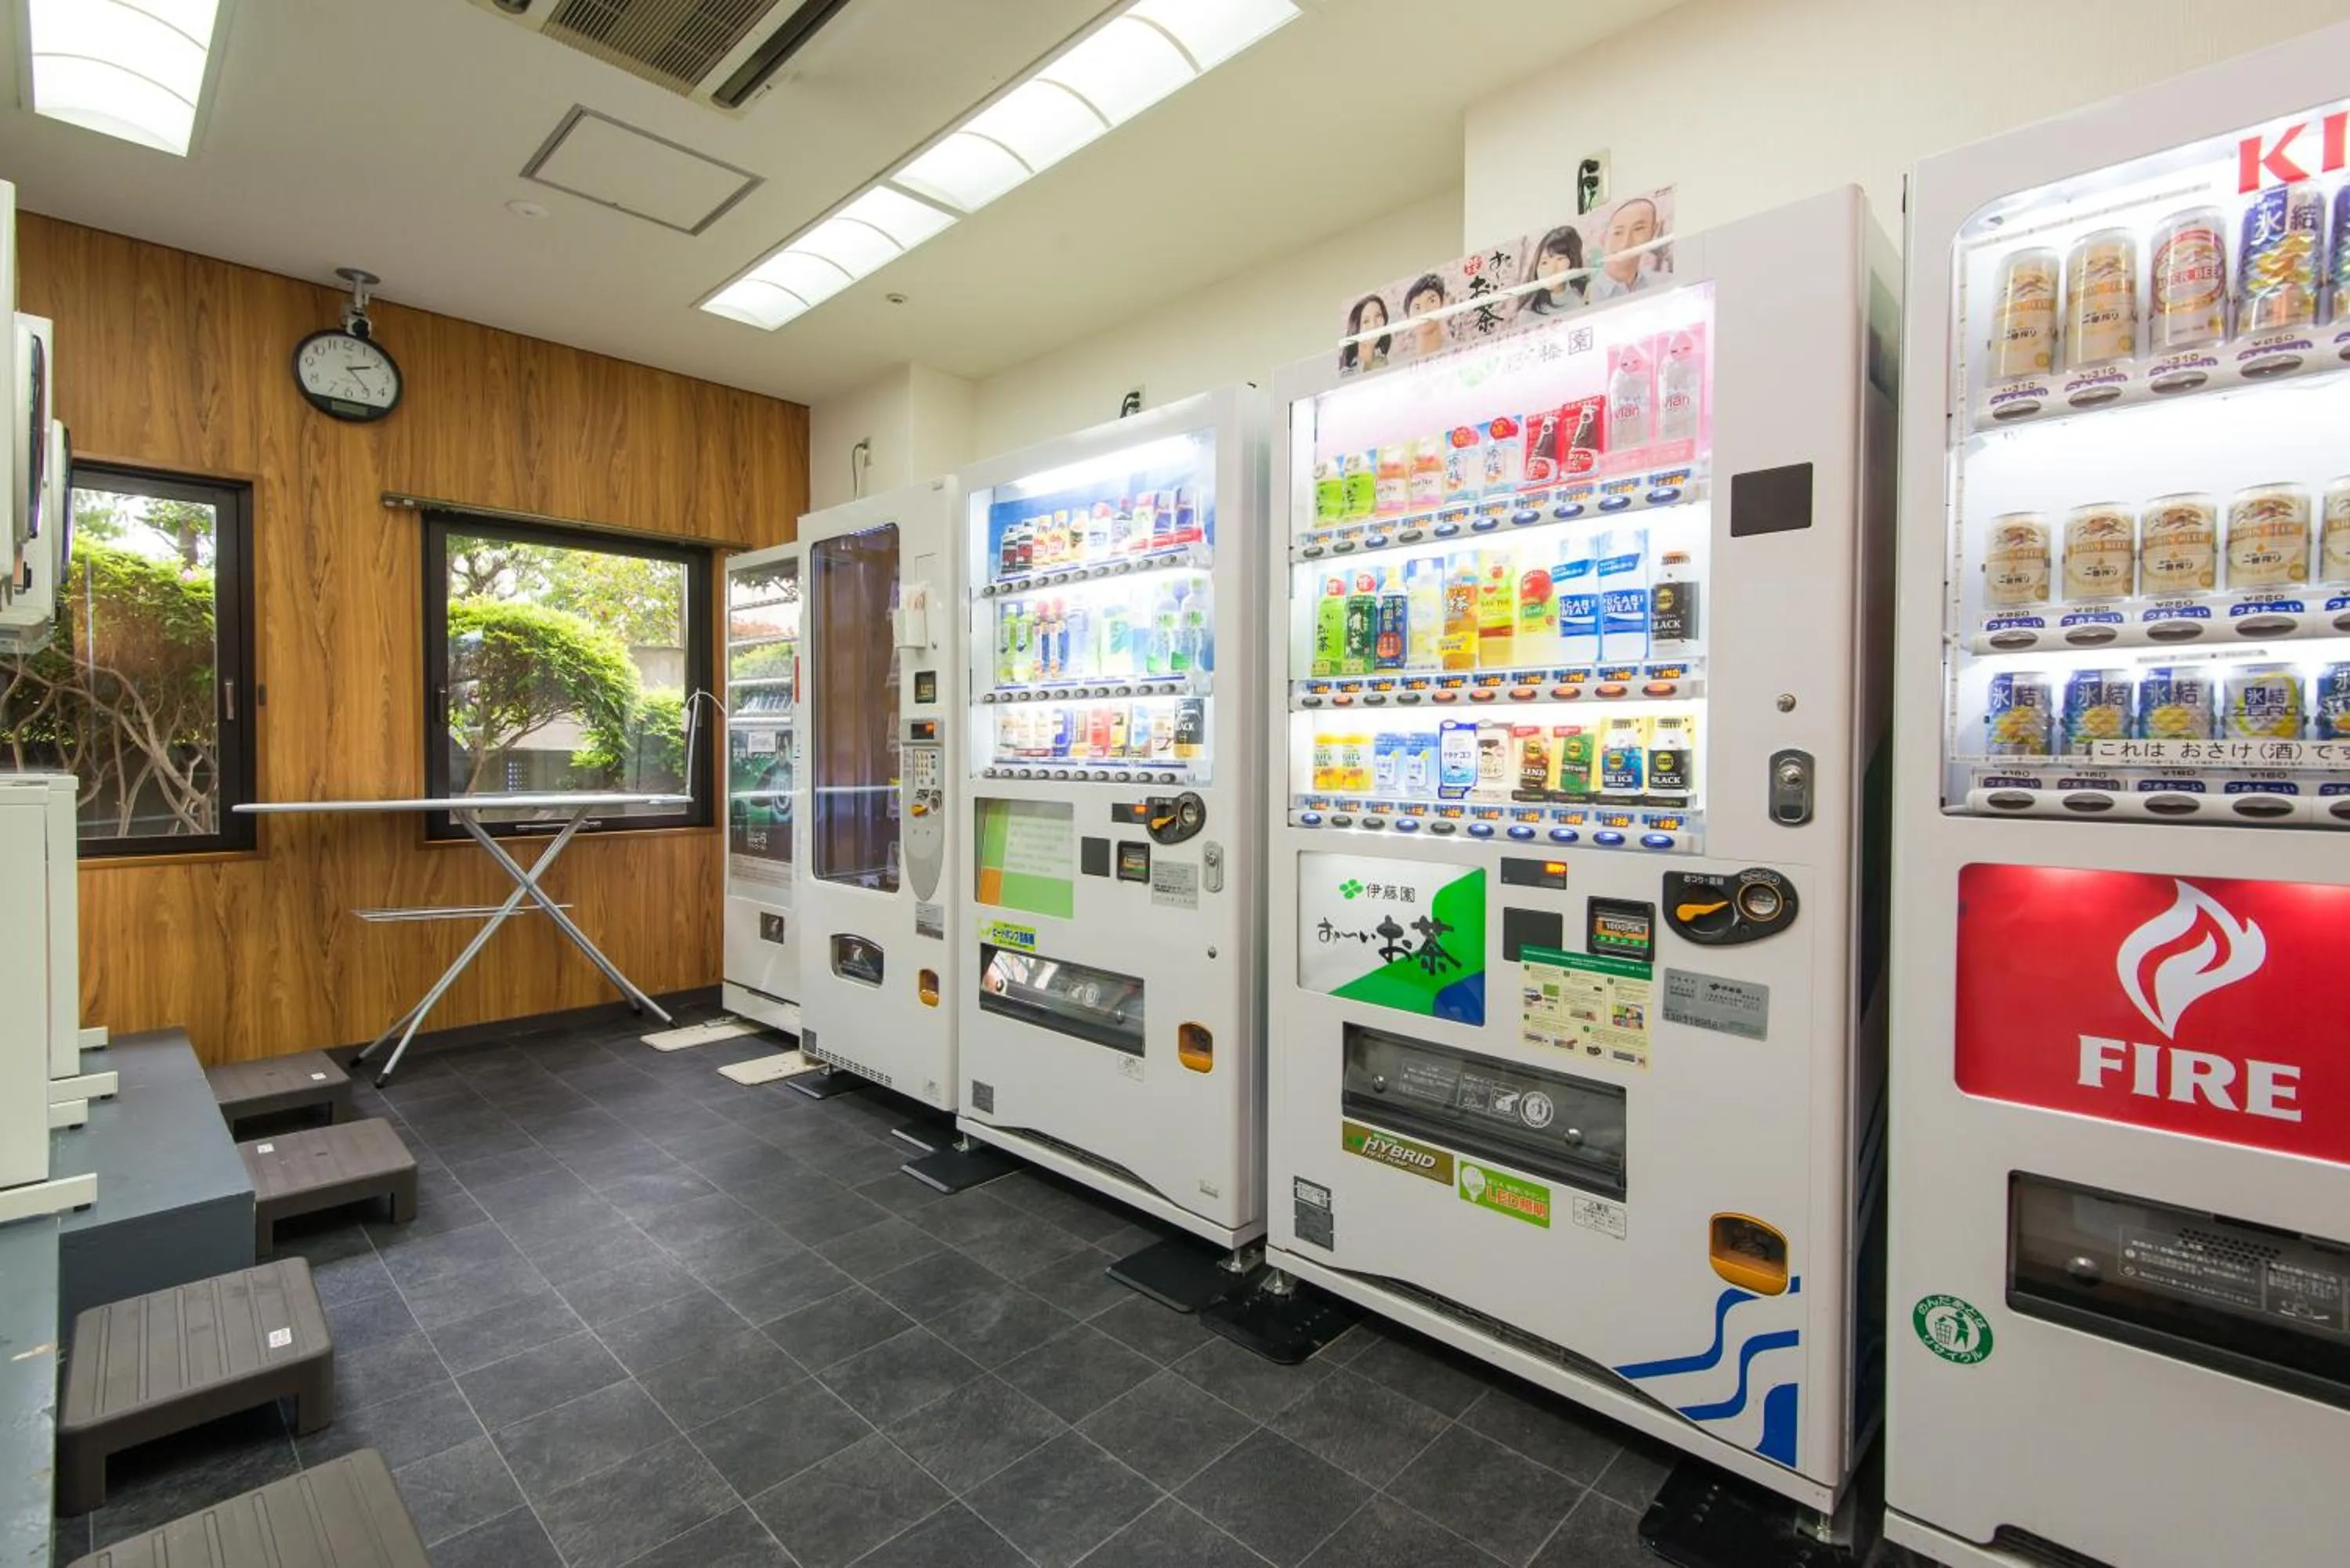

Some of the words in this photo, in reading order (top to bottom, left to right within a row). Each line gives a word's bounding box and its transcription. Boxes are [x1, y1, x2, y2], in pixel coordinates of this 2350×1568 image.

[2100, 742, 2166, 757] これは
[1365, 883, 1415, 902] 伊藤園
[2077, 1034, 2303, 1123] FIRE
[1361, 1136, 1436, 1169] HYBRID
